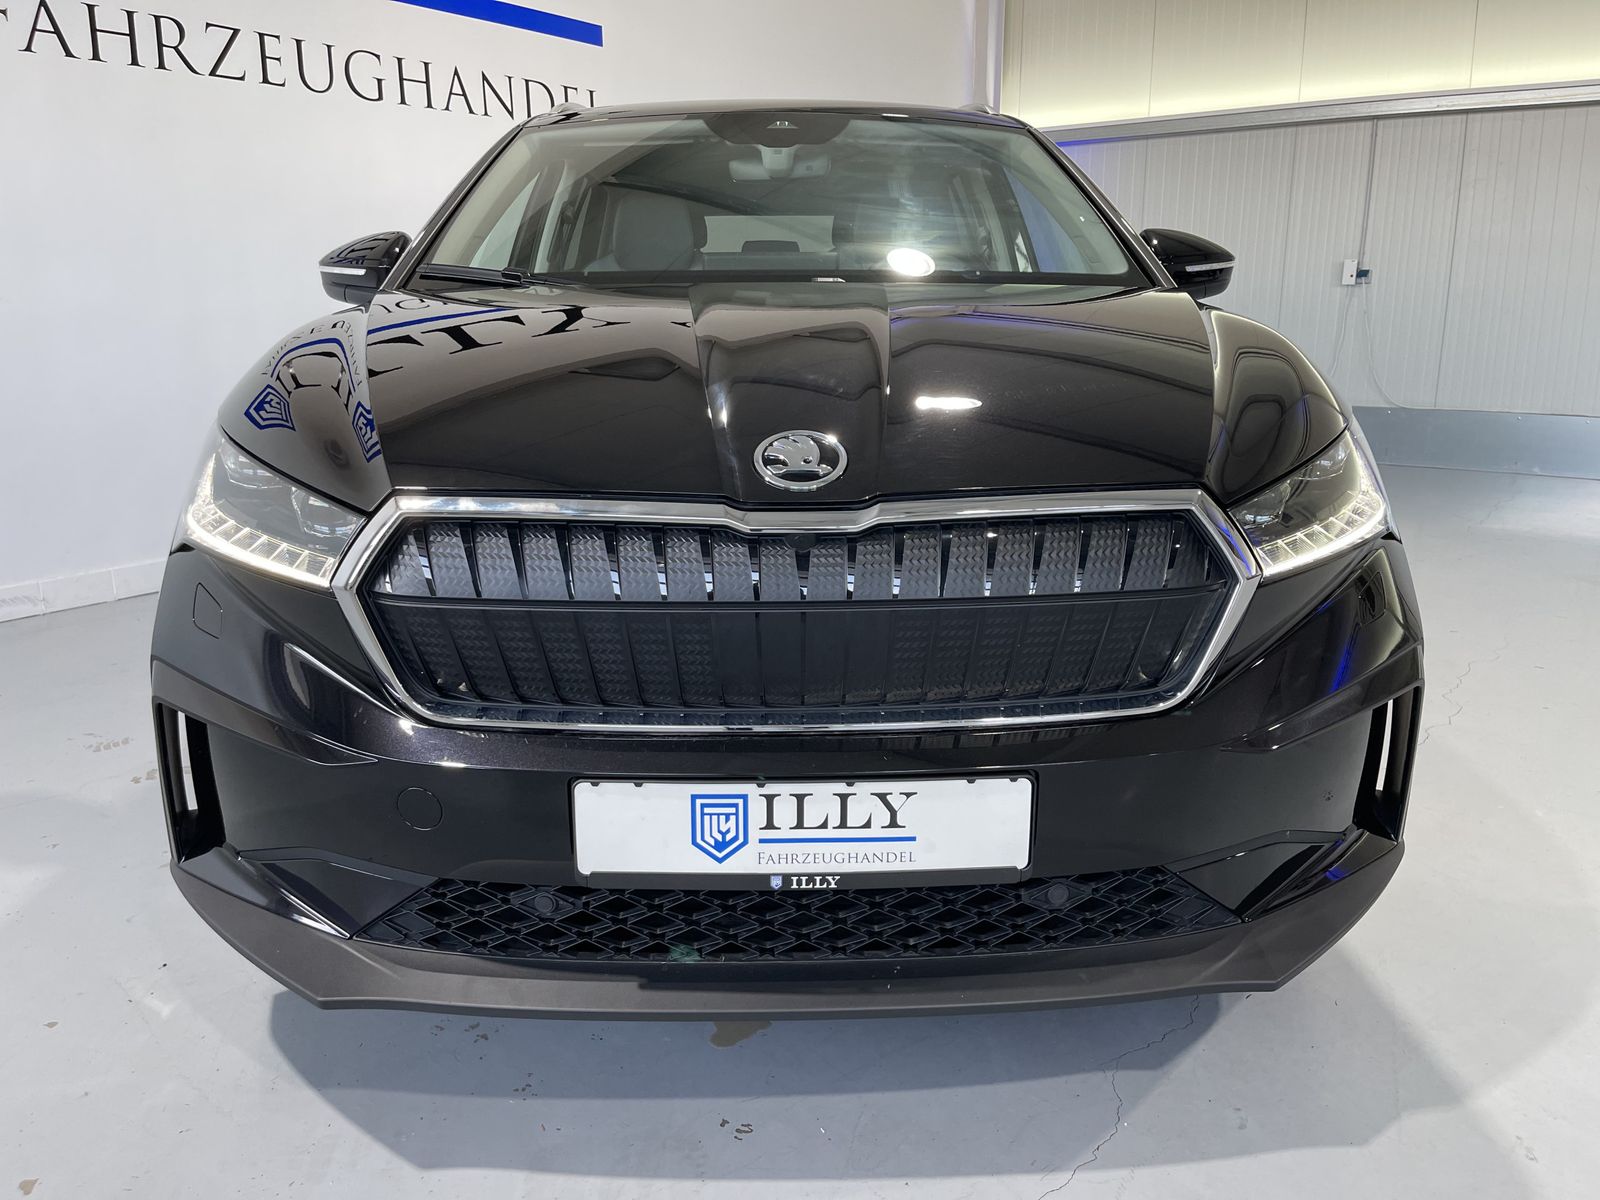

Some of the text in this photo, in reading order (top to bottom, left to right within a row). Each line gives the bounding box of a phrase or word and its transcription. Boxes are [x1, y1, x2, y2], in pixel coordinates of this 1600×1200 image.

[0, 0, 597, 121] AHRZEUGHAND
[758, 791, 918, 830] ILLY
[757, 851, 917, 865] FAHRZEUGHANDEL
[790, 875, 841, 889] ILLY
